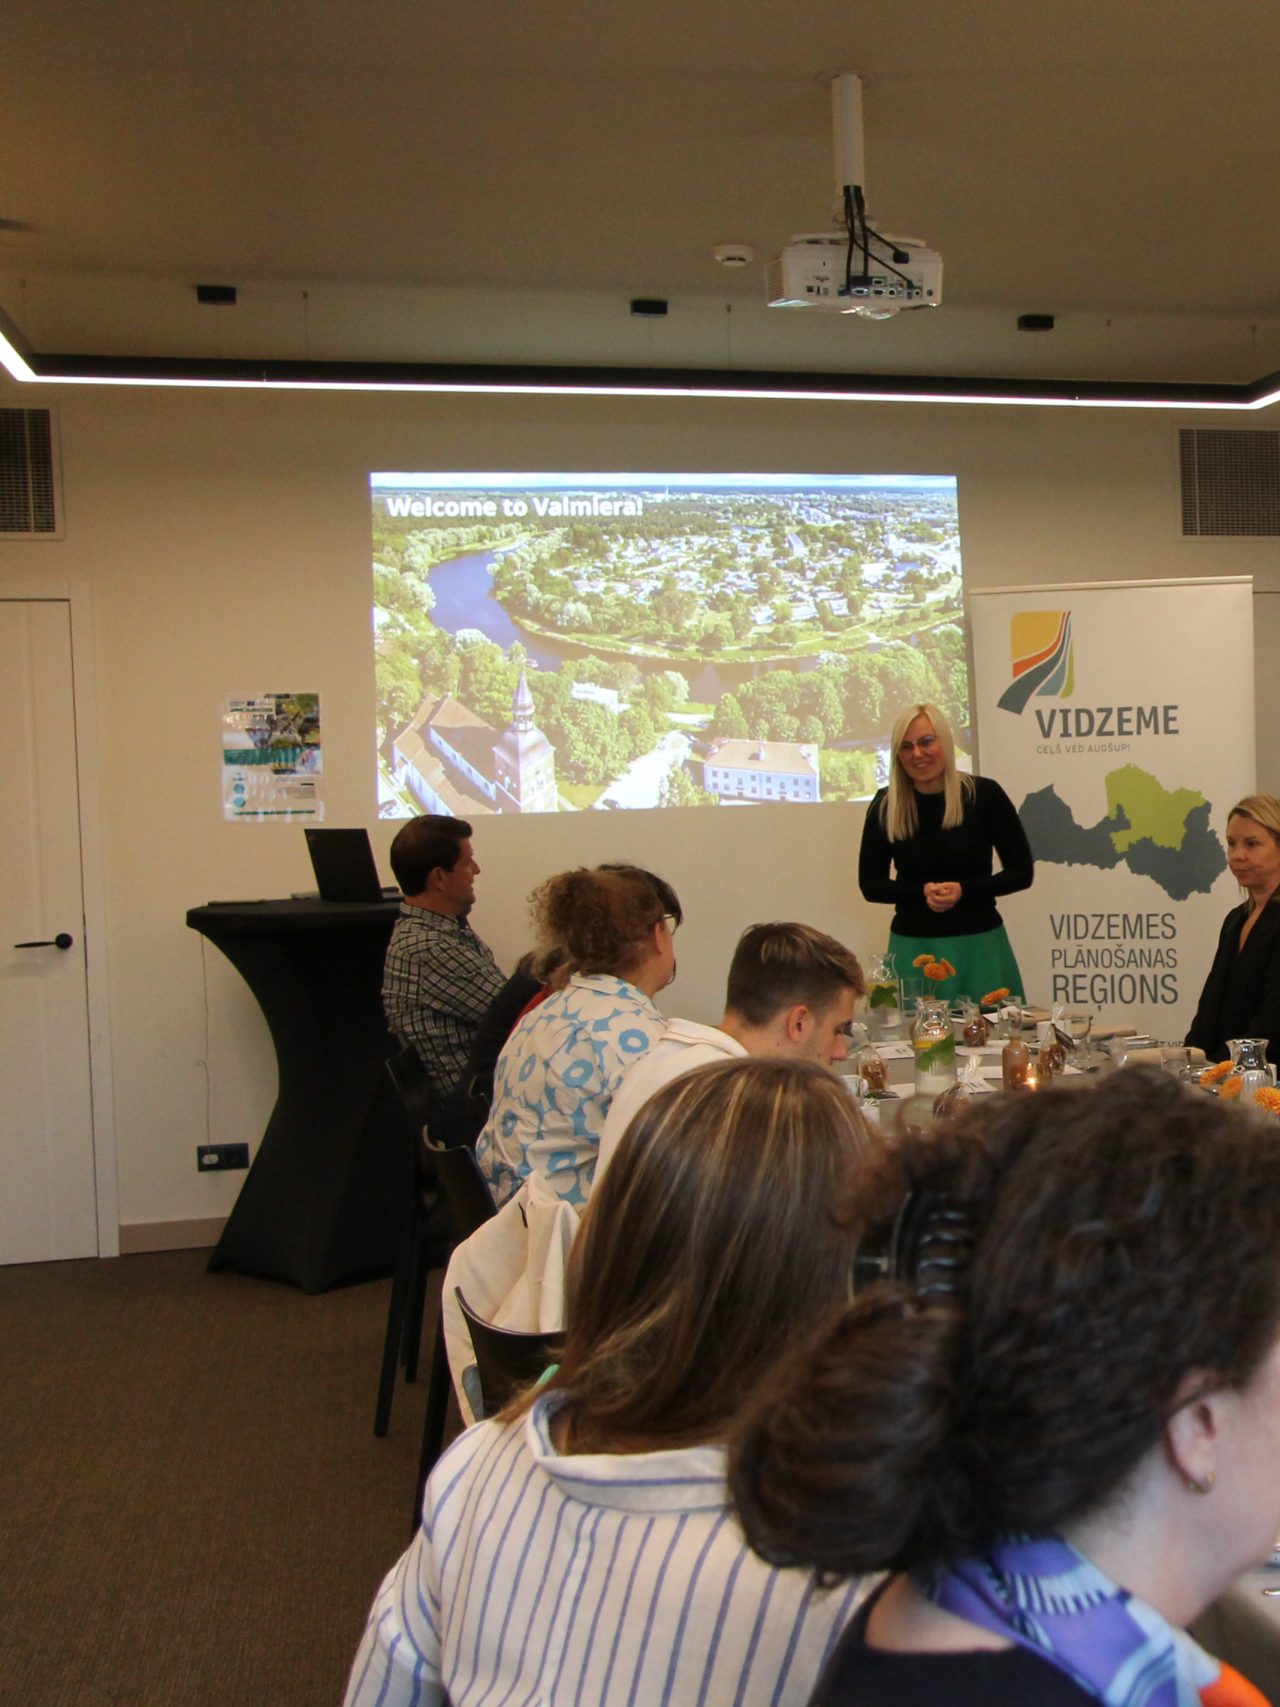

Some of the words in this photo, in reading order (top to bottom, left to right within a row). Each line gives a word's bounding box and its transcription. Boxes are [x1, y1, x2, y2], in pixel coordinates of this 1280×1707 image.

[386, 496, 497, 517] Welcome
[502, 498, 528, 517] to
[532, 494, 643, 517] Valmiera!
[1035, 705, 1180, 739] VIDZEME
[1065, 744, 1085, 753] VED
[1049, 912, 1177, 940] VIDZEMES
[1051, 943, 1178, 968] PLĀNOŠANAS
[1053, 973, 1179, 1012] REĢIONS
